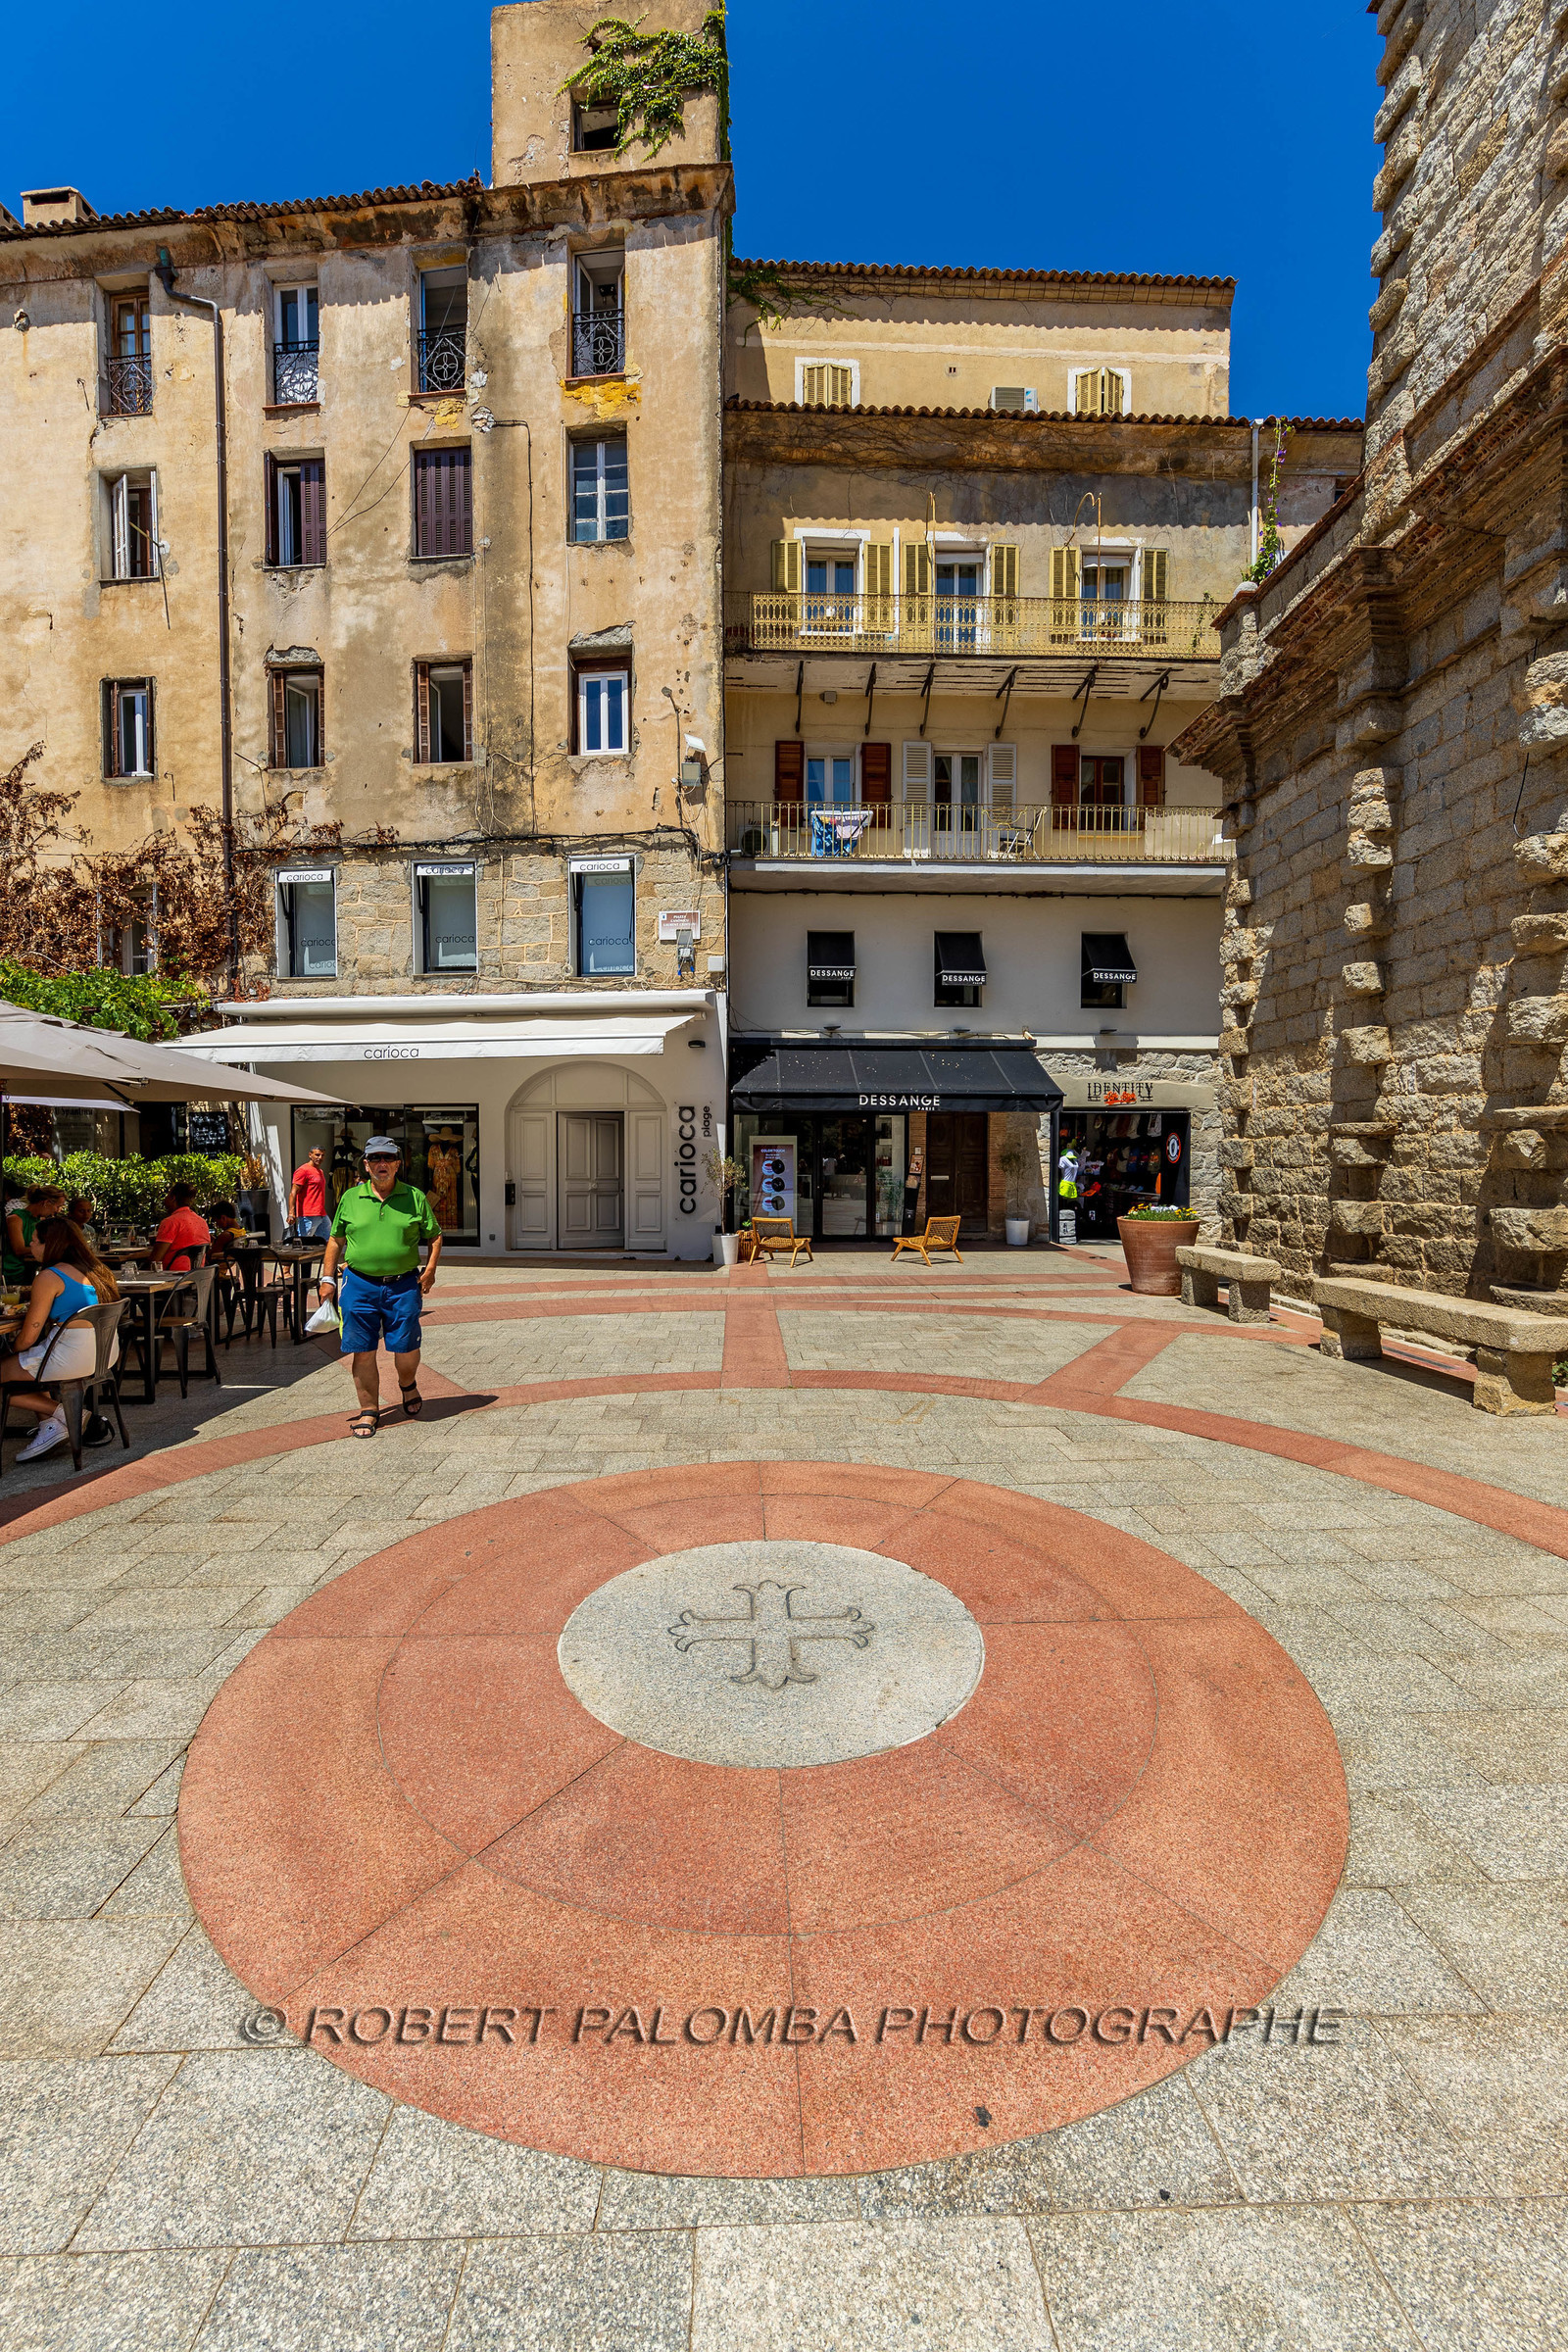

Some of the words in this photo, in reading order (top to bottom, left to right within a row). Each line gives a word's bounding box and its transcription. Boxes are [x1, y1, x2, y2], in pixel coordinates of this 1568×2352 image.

[425, 865, 465, 875] carioca
[579, 862, 620, 871] carioca
[286, 872, 323, 882] carioca
[435, 934, 474, 944] carioca
[588, 936, 629, 946] carioca
[364, 1045, 419, 1059] carioca
[1087, 1082, 1153, 1099] IDENTITY
[858, 1094, 941, 1106] DESSANGE
[702, 1105, 712, 1138] plage
[674, 1105, 697, 1215] carioca
